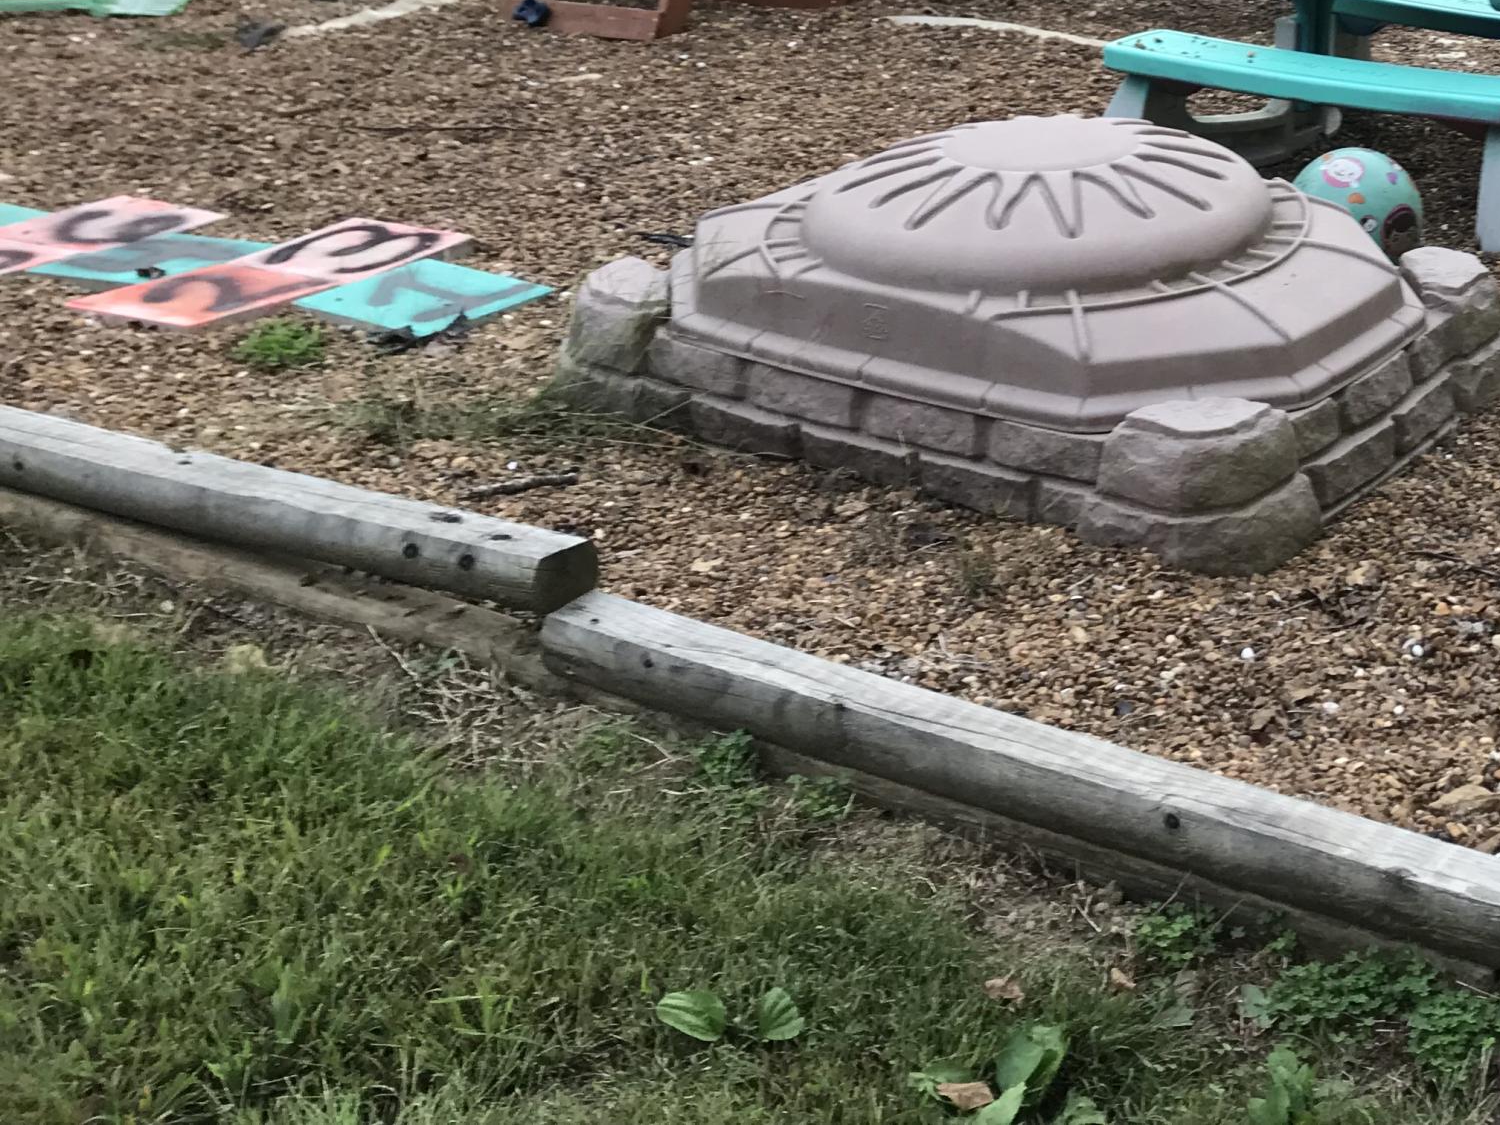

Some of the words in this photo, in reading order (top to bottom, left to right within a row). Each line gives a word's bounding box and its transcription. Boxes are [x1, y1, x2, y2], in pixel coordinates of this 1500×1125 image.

[265, 225, 441, 274] 3
[142, 275, 332, 313] 2
[367, 270, 537, 323] 1
